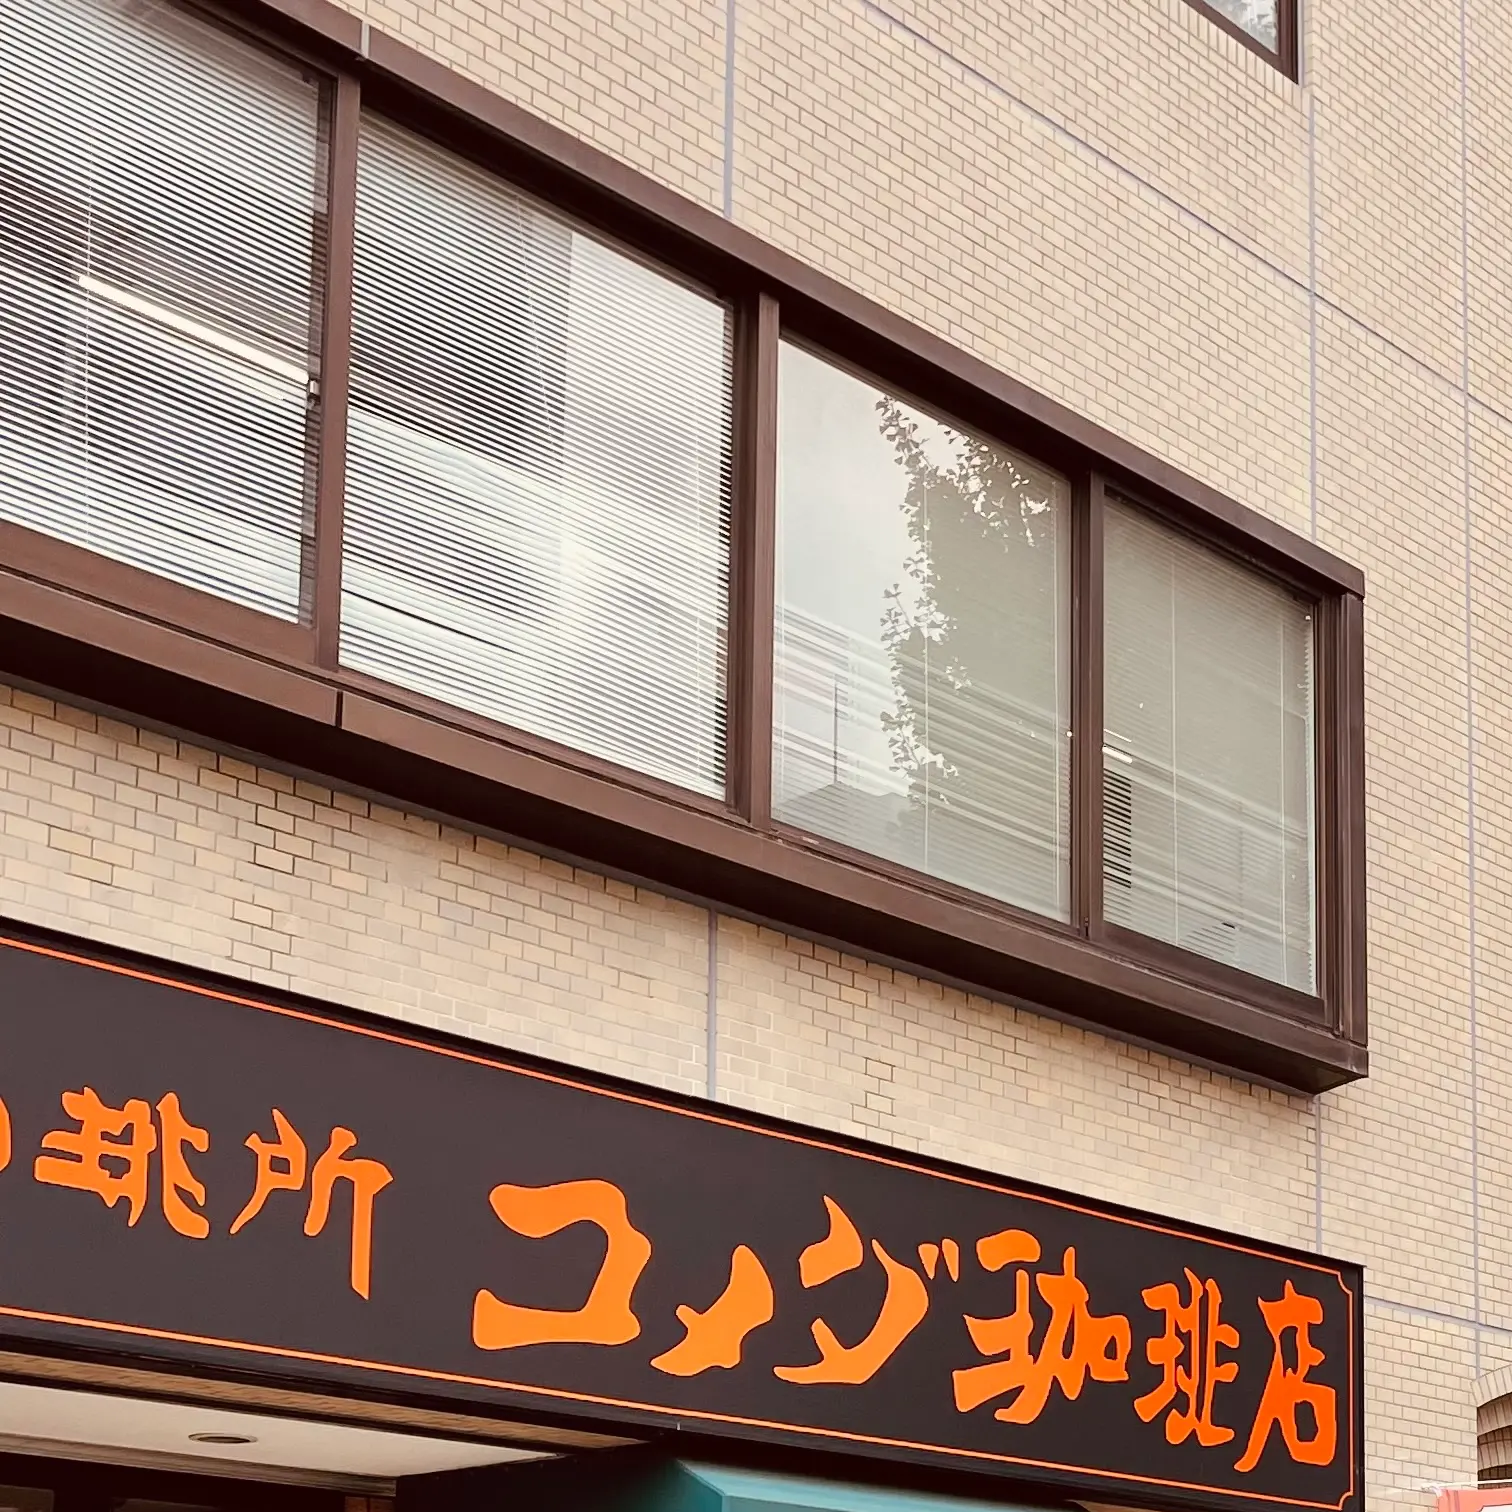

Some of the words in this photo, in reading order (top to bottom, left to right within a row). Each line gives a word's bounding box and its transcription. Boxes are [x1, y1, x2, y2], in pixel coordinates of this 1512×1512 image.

[0, 1086, 394, 1300] 琲所
[473, 1179, 1337, 1472] コメダ珈琲店
